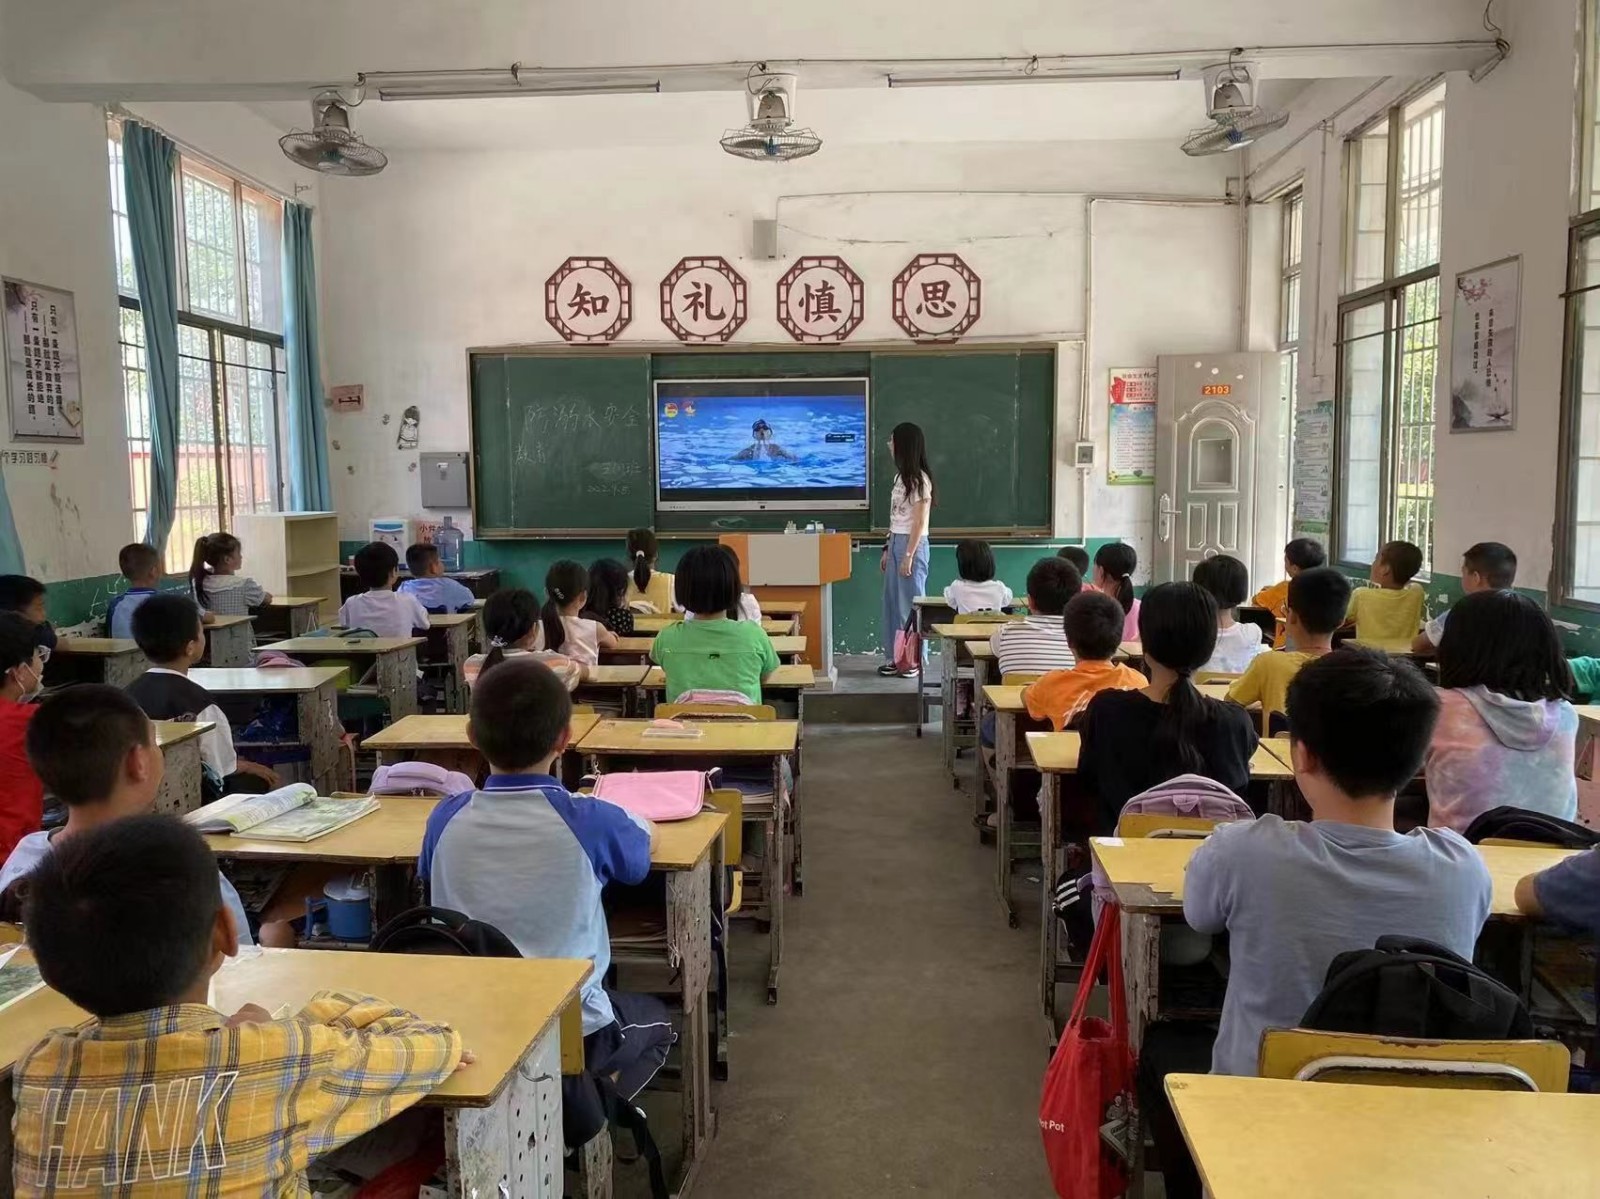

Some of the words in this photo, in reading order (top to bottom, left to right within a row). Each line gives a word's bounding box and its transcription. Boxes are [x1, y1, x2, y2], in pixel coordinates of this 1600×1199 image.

[567, 281, 609, 320] 知
[682, 281, 726, 322] 礼
[798, 280, 842, 323] 慎
[916, 279, 956, 318] 思
[1204, 385, 1229, 395] 2103
[524, 402, 640, 434] 防溺水安全
[1049, 1119, 1064, 1133] Pot
